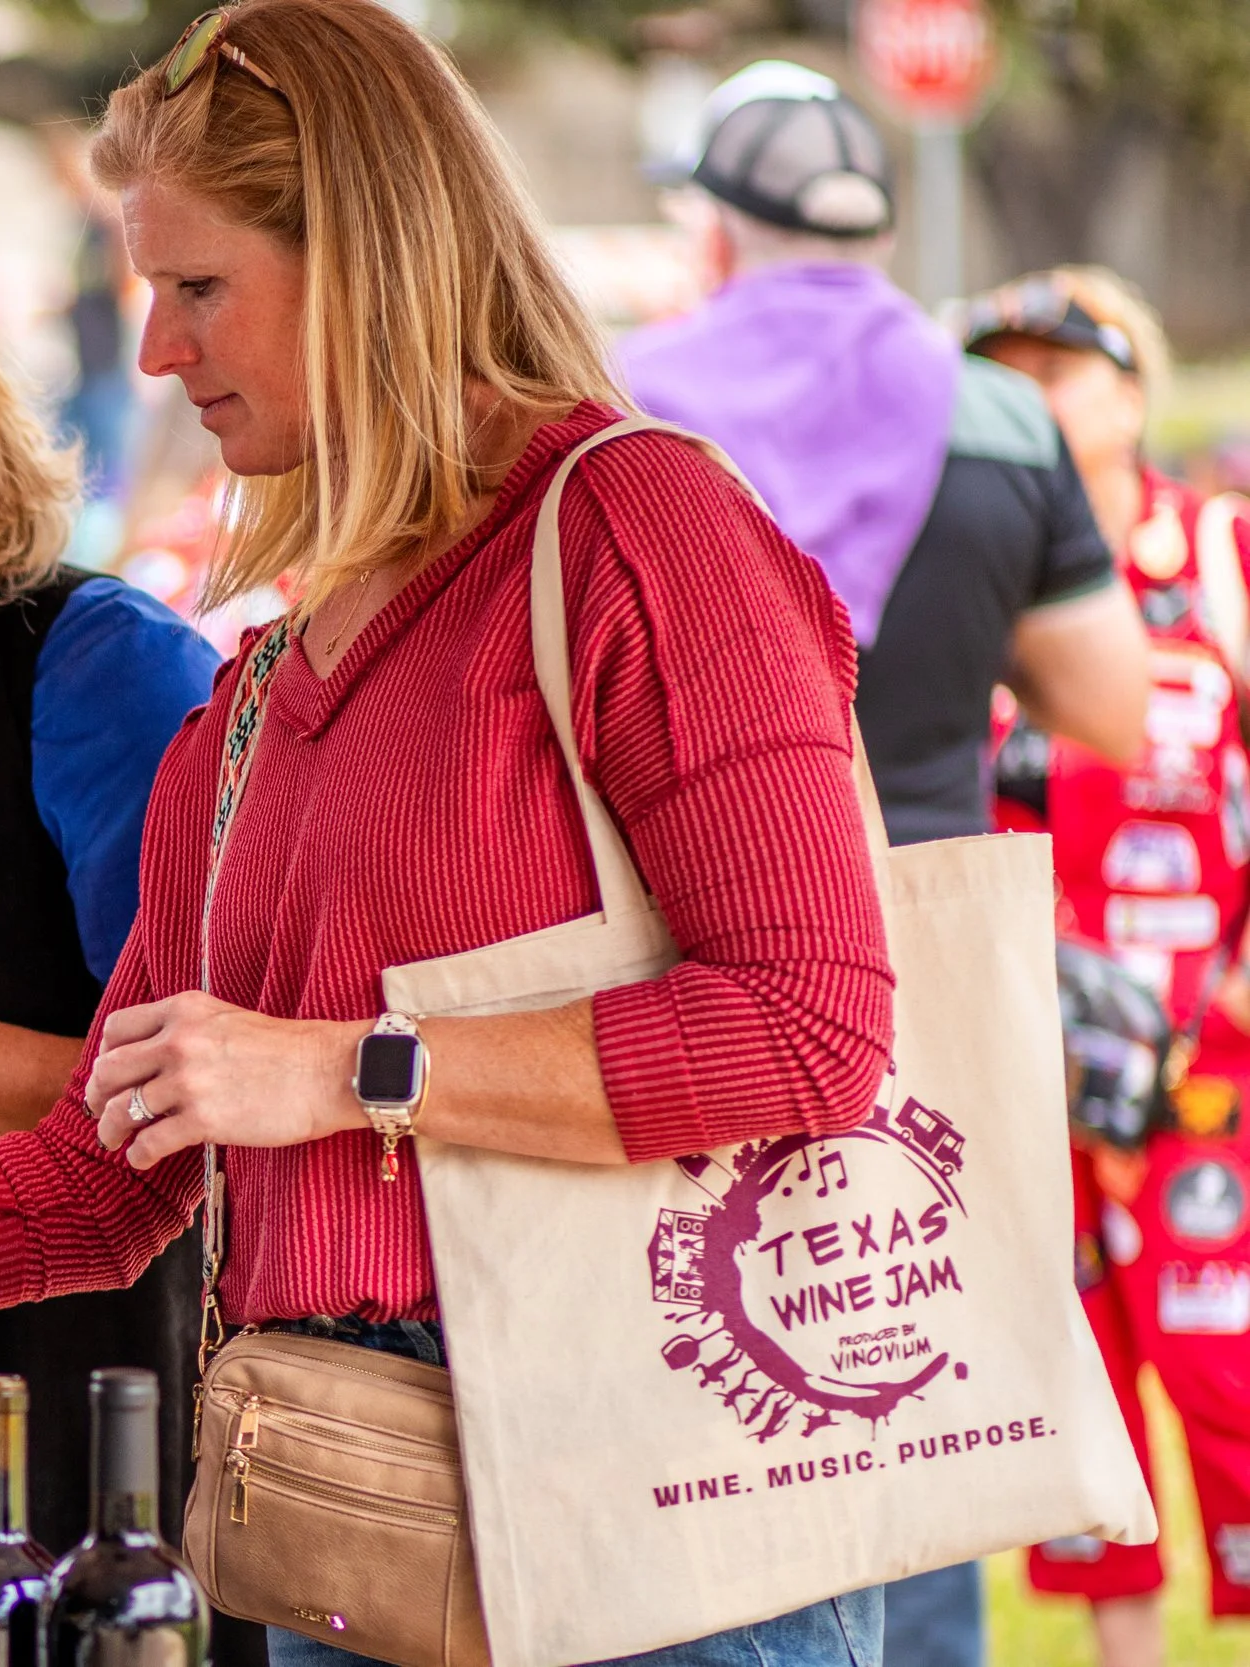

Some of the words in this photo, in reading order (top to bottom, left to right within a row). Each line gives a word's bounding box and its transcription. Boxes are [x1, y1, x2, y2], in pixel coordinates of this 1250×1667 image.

[758, 1201, 948, 1277] TEXAS
[769, 1273, 875, 1331] WINE
[885, 1255, 963, 1308] JAM
[830, 1336, 932, 1373] VINOVIUM
[838, 1327, 899, 1347] PRODUCED
[901, 1323, 917, 1337] BY
[652, 1473, 754, 1509] WINE.
[766, 1450, 886, 1489] MUSIC.
[897, 1416, 1058, 1465] PURPOSE.
